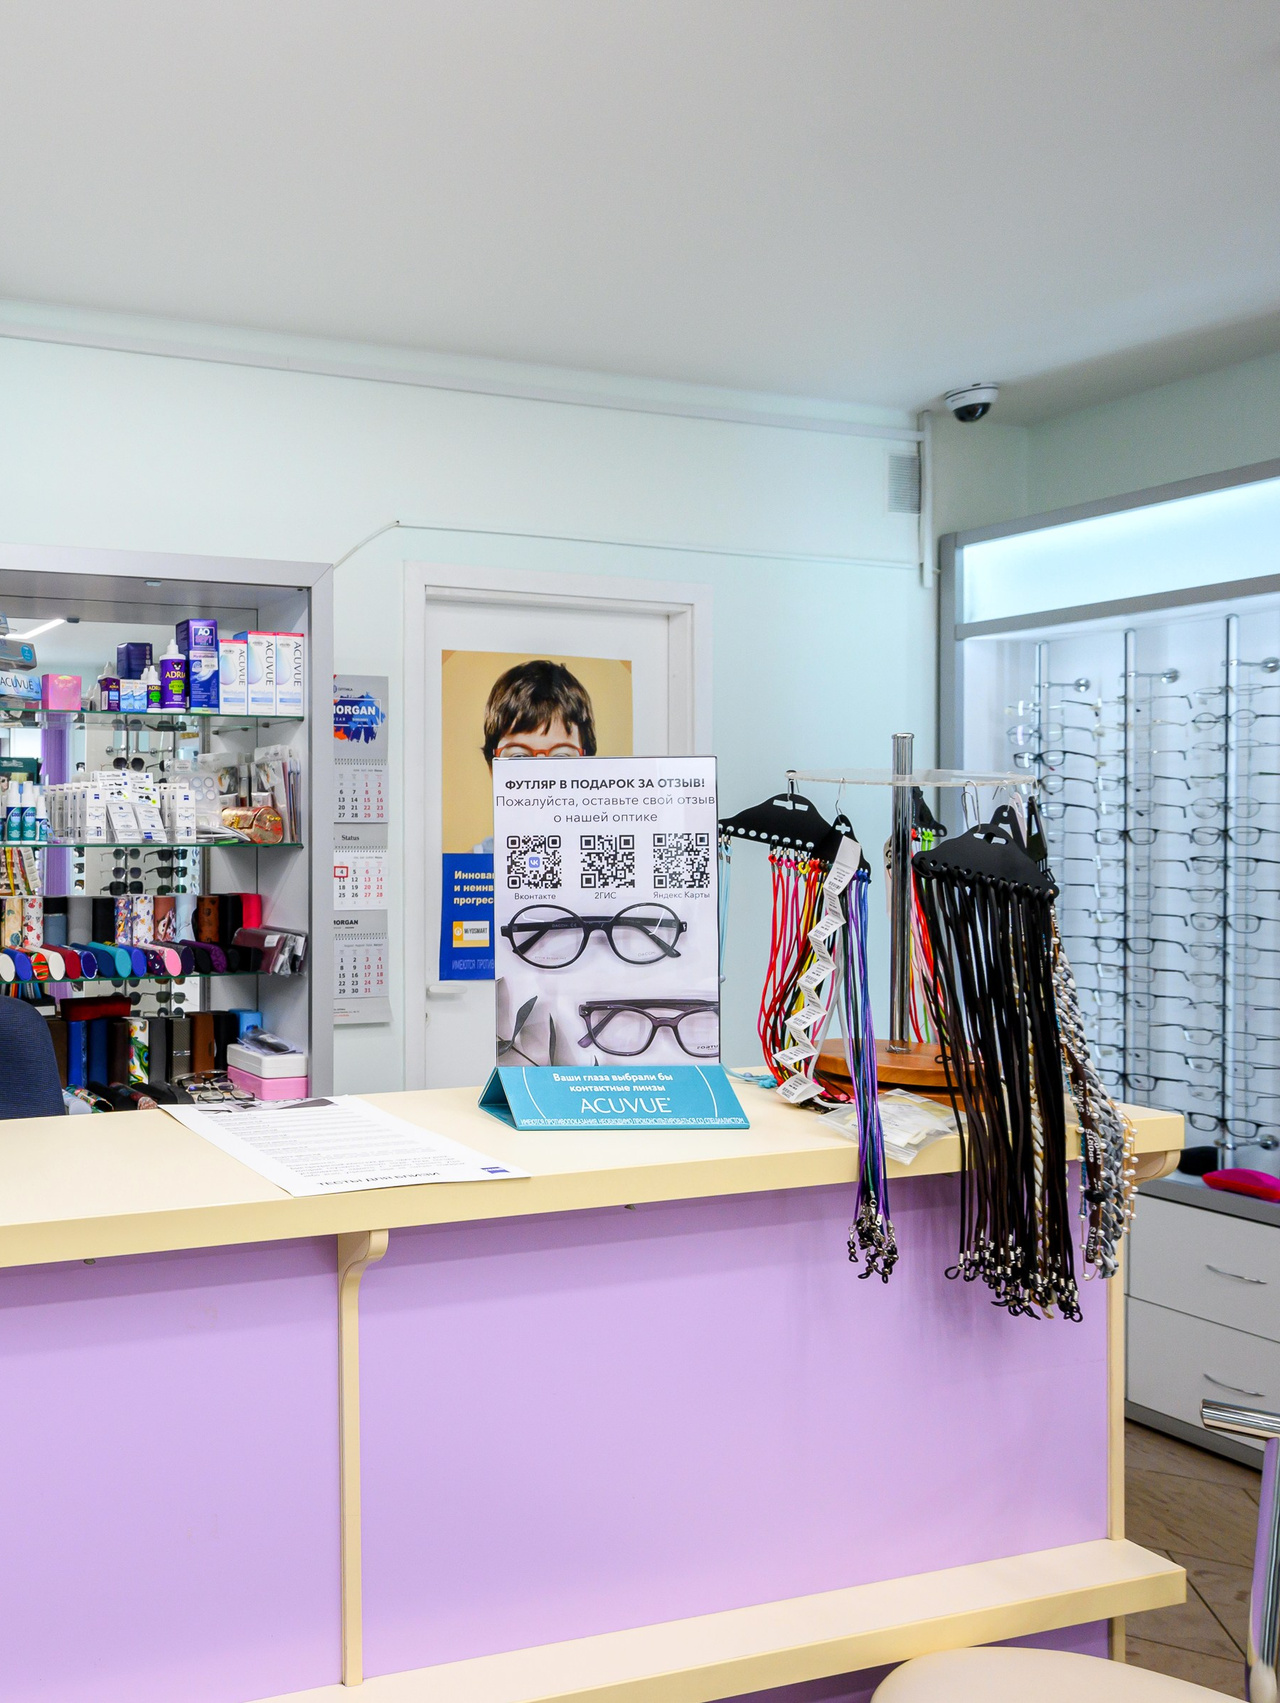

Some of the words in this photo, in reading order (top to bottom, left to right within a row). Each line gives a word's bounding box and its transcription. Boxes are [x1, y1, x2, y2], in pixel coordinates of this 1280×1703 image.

[238, 648, 246, 686] ACUVUE
[265, 640, 274, 686] ACUVUE
[293, 641, 302, 686] ACUVUE
[0, 676, 34, 690] ACUVUE
[505, 780, 557, 790] ФУТЛЯР
[559, 780, 568, 789] В
[571, 779, 635, 790] ПОДАРОК
[638, 779, 654, 788] ЗА
[657, 778, 705, 788] ОТЗЫВ!
[496, 796, 578, 809] Пожалуйста,
[582, 797, 639, 806] оставьте
[642, 794, 673, 805] свой
[677, 796, 715, 805] отзыв
[553, 815, 561, 823] о
[565, 812, 608, 823] нашей
[612, 813, 658, 822] оптике
[453, 897, 494, 906] прогрес
[514, 892, 556, 900] Вконтакте
[653, 892, 683, 900] Яндекс
[685, 891, 711, 900] Карты
[452, 959, 476, 970] ИМЕЮТСЯ
[552, 1073, 581, 1082] Ваши
[611, 1073, 656, 1083] выбрали
[657, 1072, 673, 1080] бы
[581, 1098, 672, 1113] ACUVUE
[1086, 1128, 1094, 1162] SPORTS
